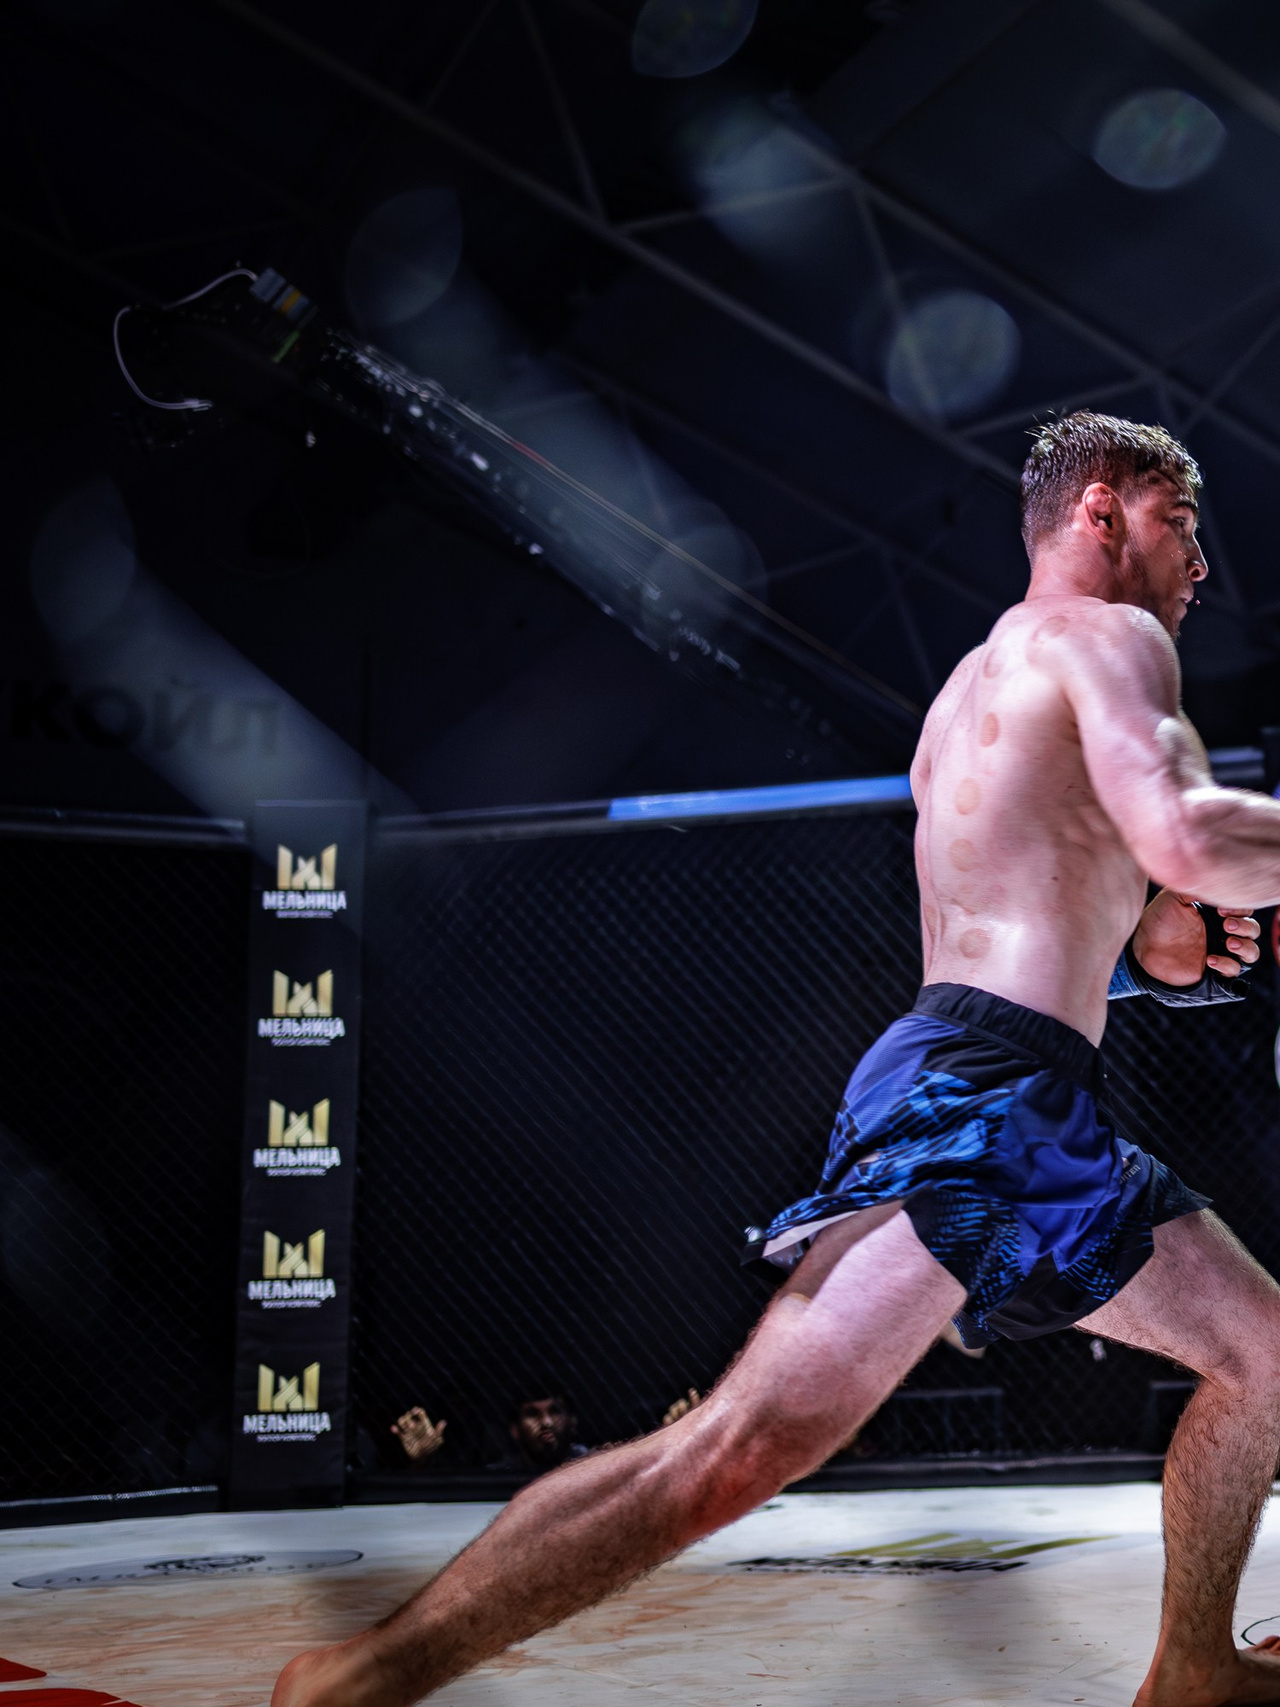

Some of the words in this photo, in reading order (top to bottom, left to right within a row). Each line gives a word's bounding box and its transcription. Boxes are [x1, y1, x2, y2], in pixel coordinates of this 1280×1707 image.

[262, 890, 347, 911] МЕЛЬНИЦА
[257, 1017, 345, 1039] МЕЛЬНИЦА
[253, 1146, 341, 1169] МЕЛЬНИЦА
[248, 1278, 336, 1301] МЕЛЬНИЦА
[243, 1412, 331, 1434] МЕЛЬНИЦА
